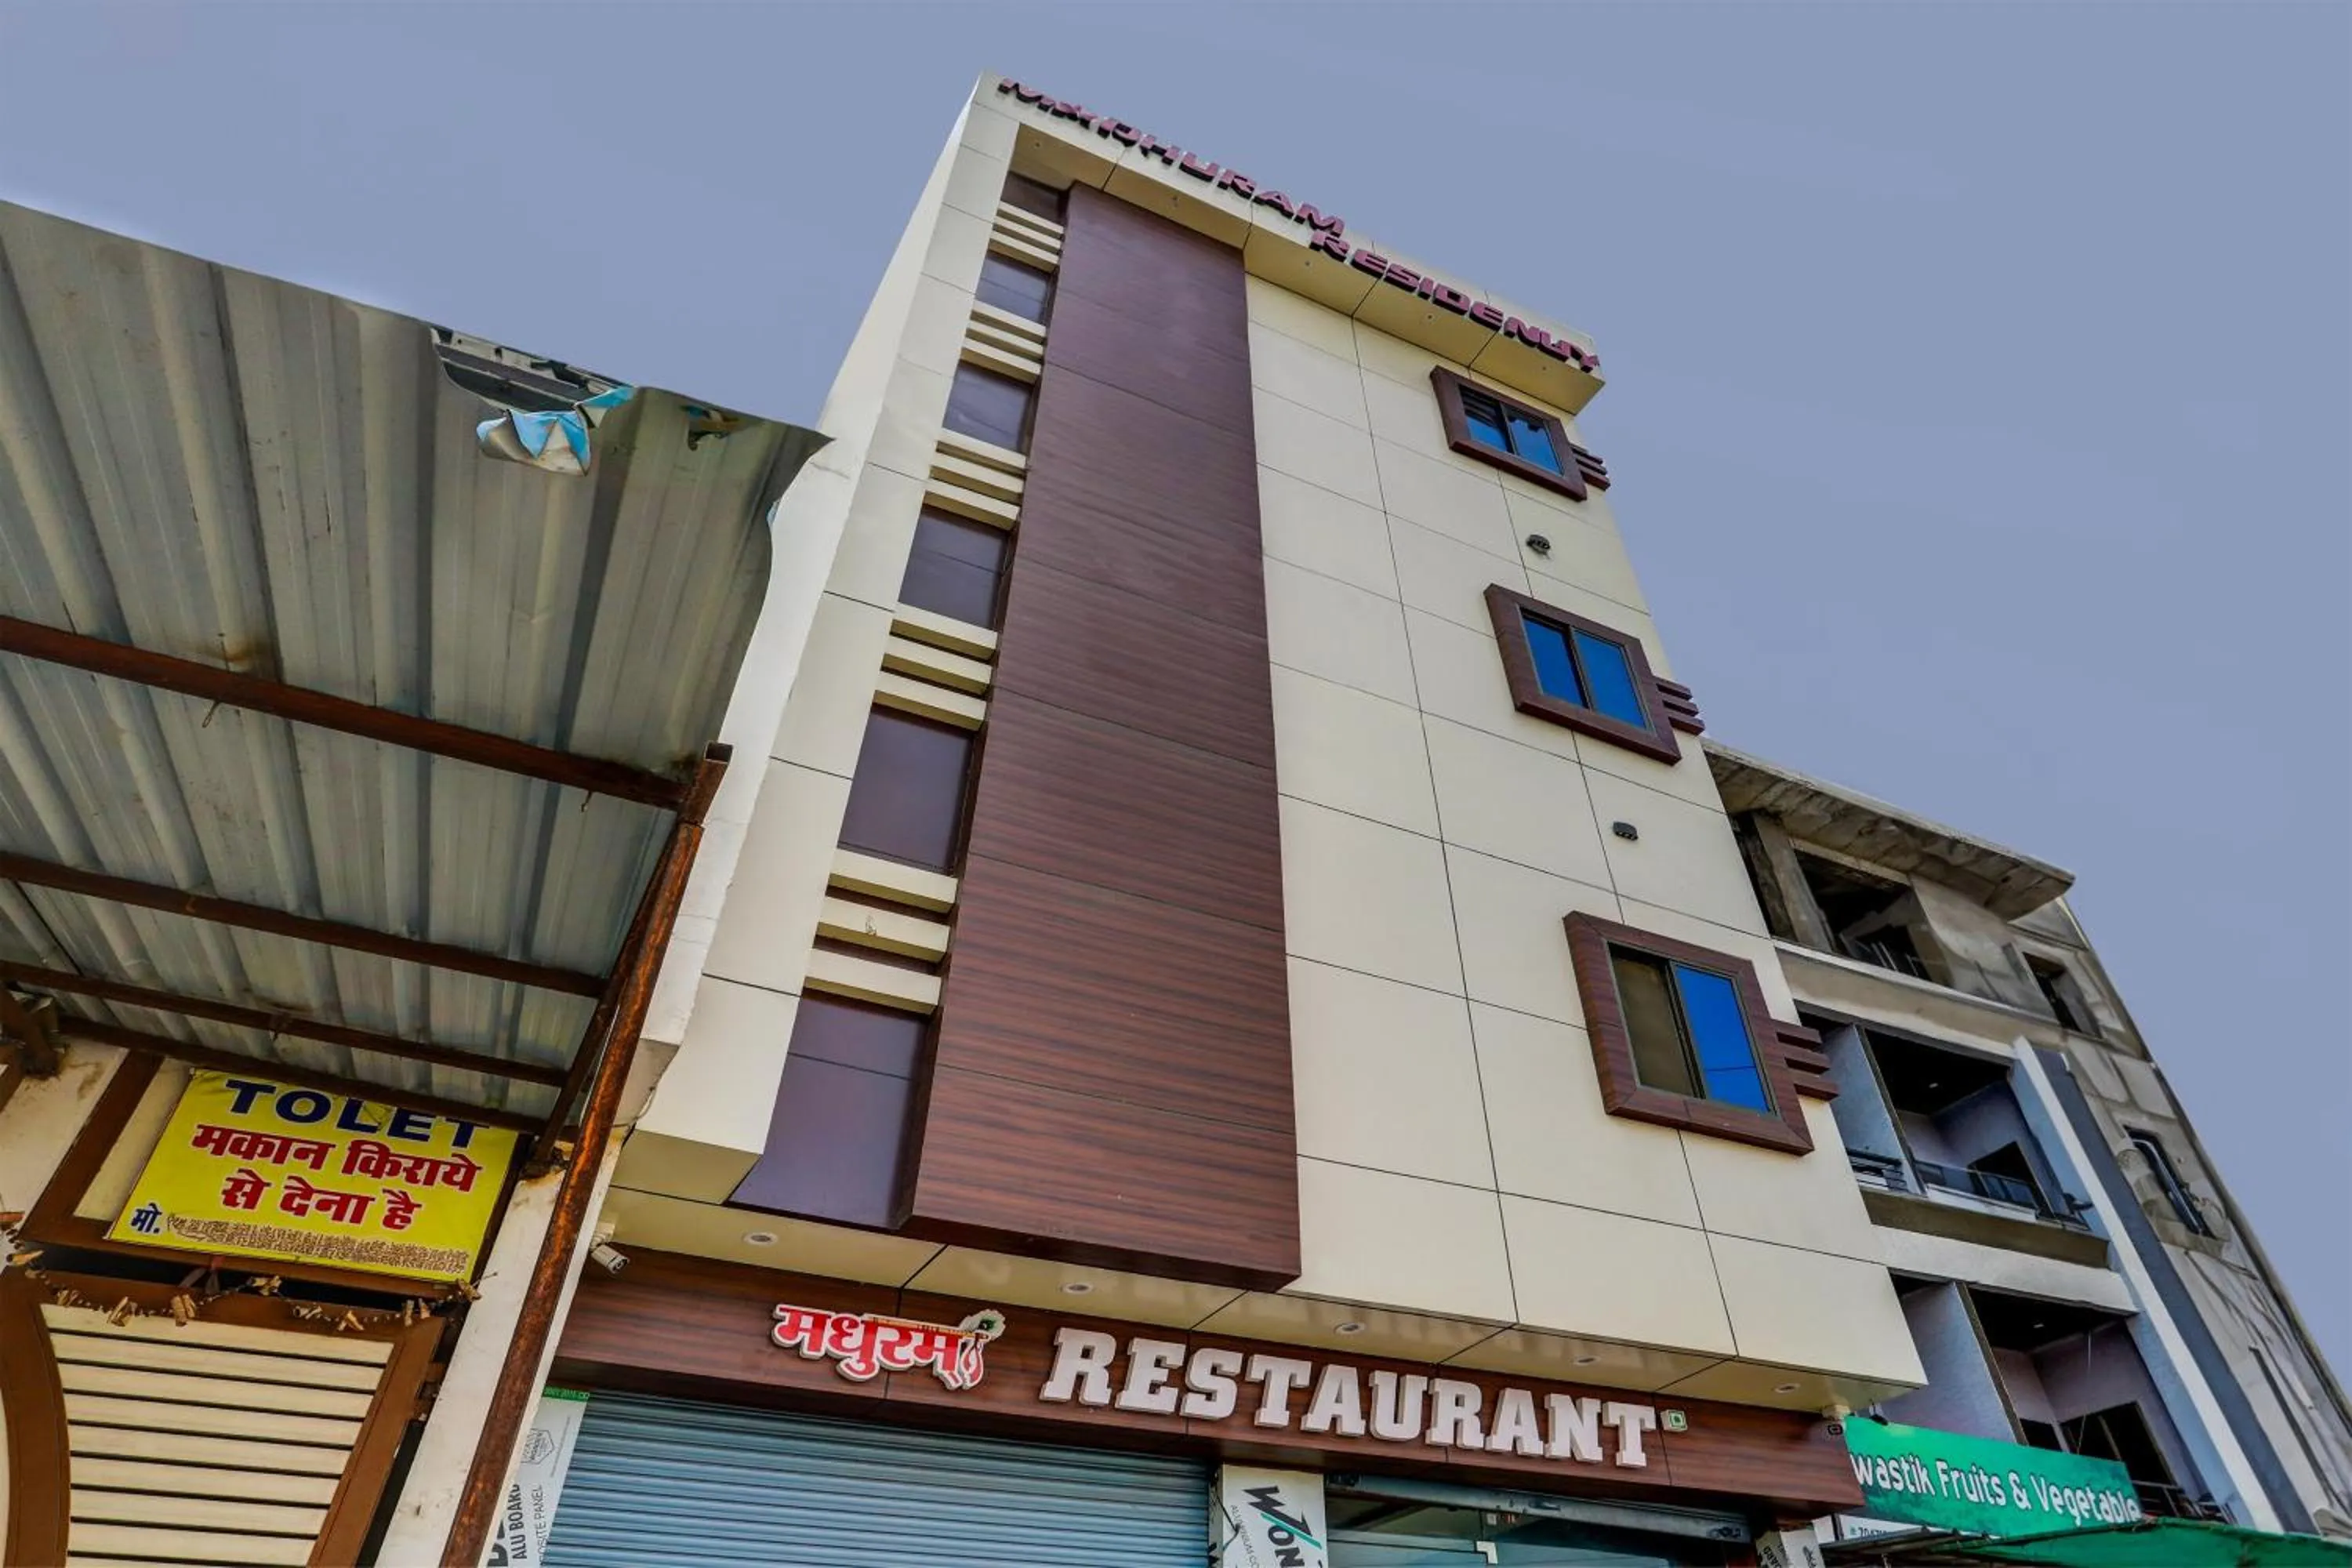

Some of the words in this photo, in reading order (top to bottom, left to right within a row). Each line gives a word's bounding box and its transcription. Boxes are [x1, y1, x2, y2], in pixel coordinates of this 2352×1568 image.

[191, 1124, 336, 1171] मकान
[341, 1138, 482, 1193] किराये
[220, 1168, 271, 1210] से
[279, 1176, 376, 1226] देना
[383, 1188, 423, 1231] है
[1039, 1327, 1657, 1468] RESTAURANT
[532, 1484, 546, 1522] PANEL
[1935, 1458, 2006, 1506] Fruits
[2008, 1470, 2031, 1511] &
[510, 1534, 528, 1559] ALU
